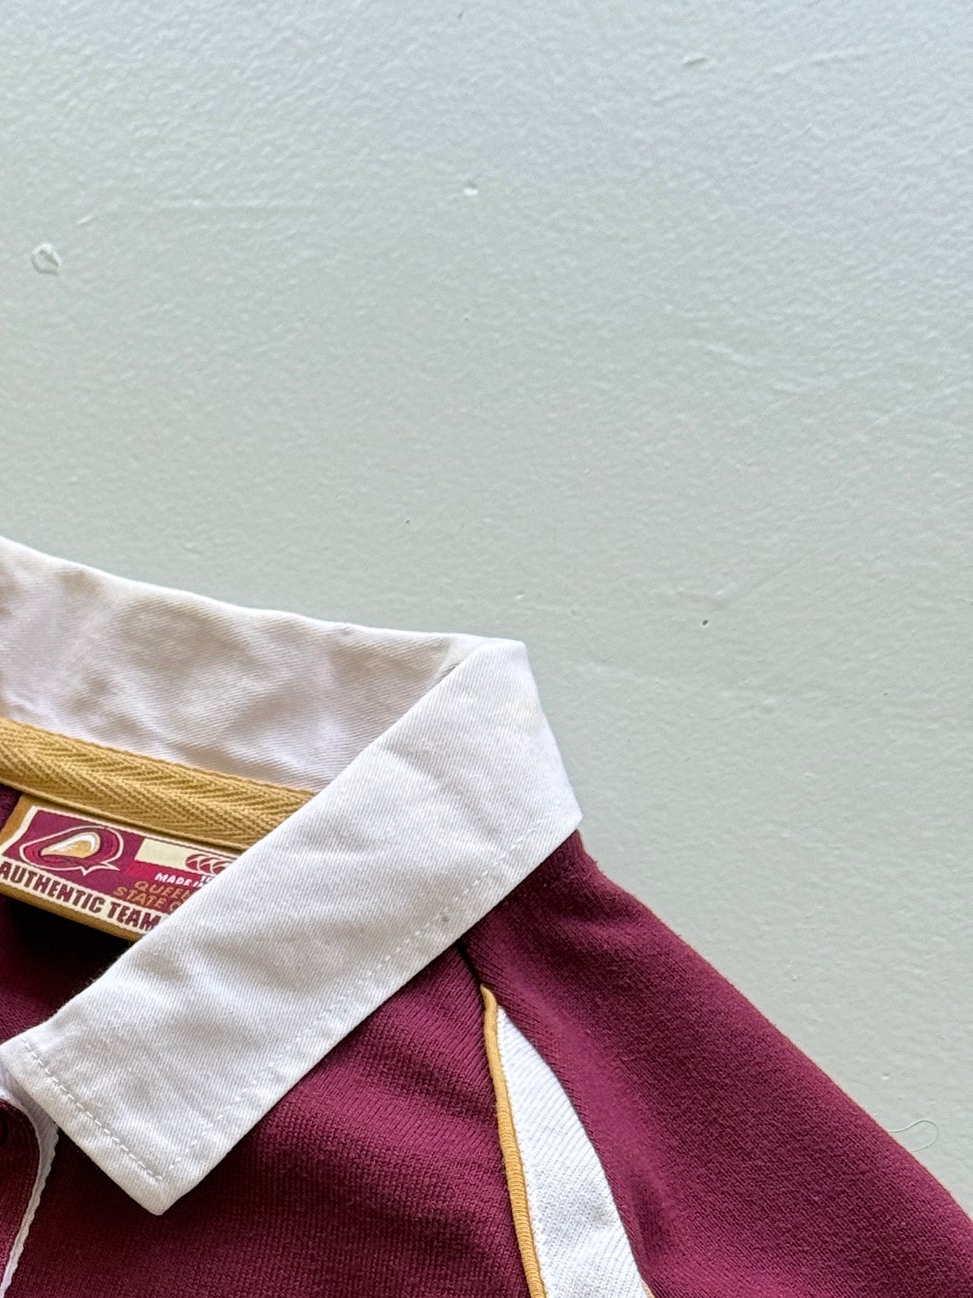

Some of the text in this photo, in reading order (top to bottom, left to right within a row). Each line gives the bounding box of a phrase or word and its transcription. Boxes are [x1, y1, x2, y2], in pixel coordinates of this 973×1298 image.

[154, 872, 191, 887] MADE
[114, 886, 166, 909] STATE
[106, 901, 161, 931] TEAM
